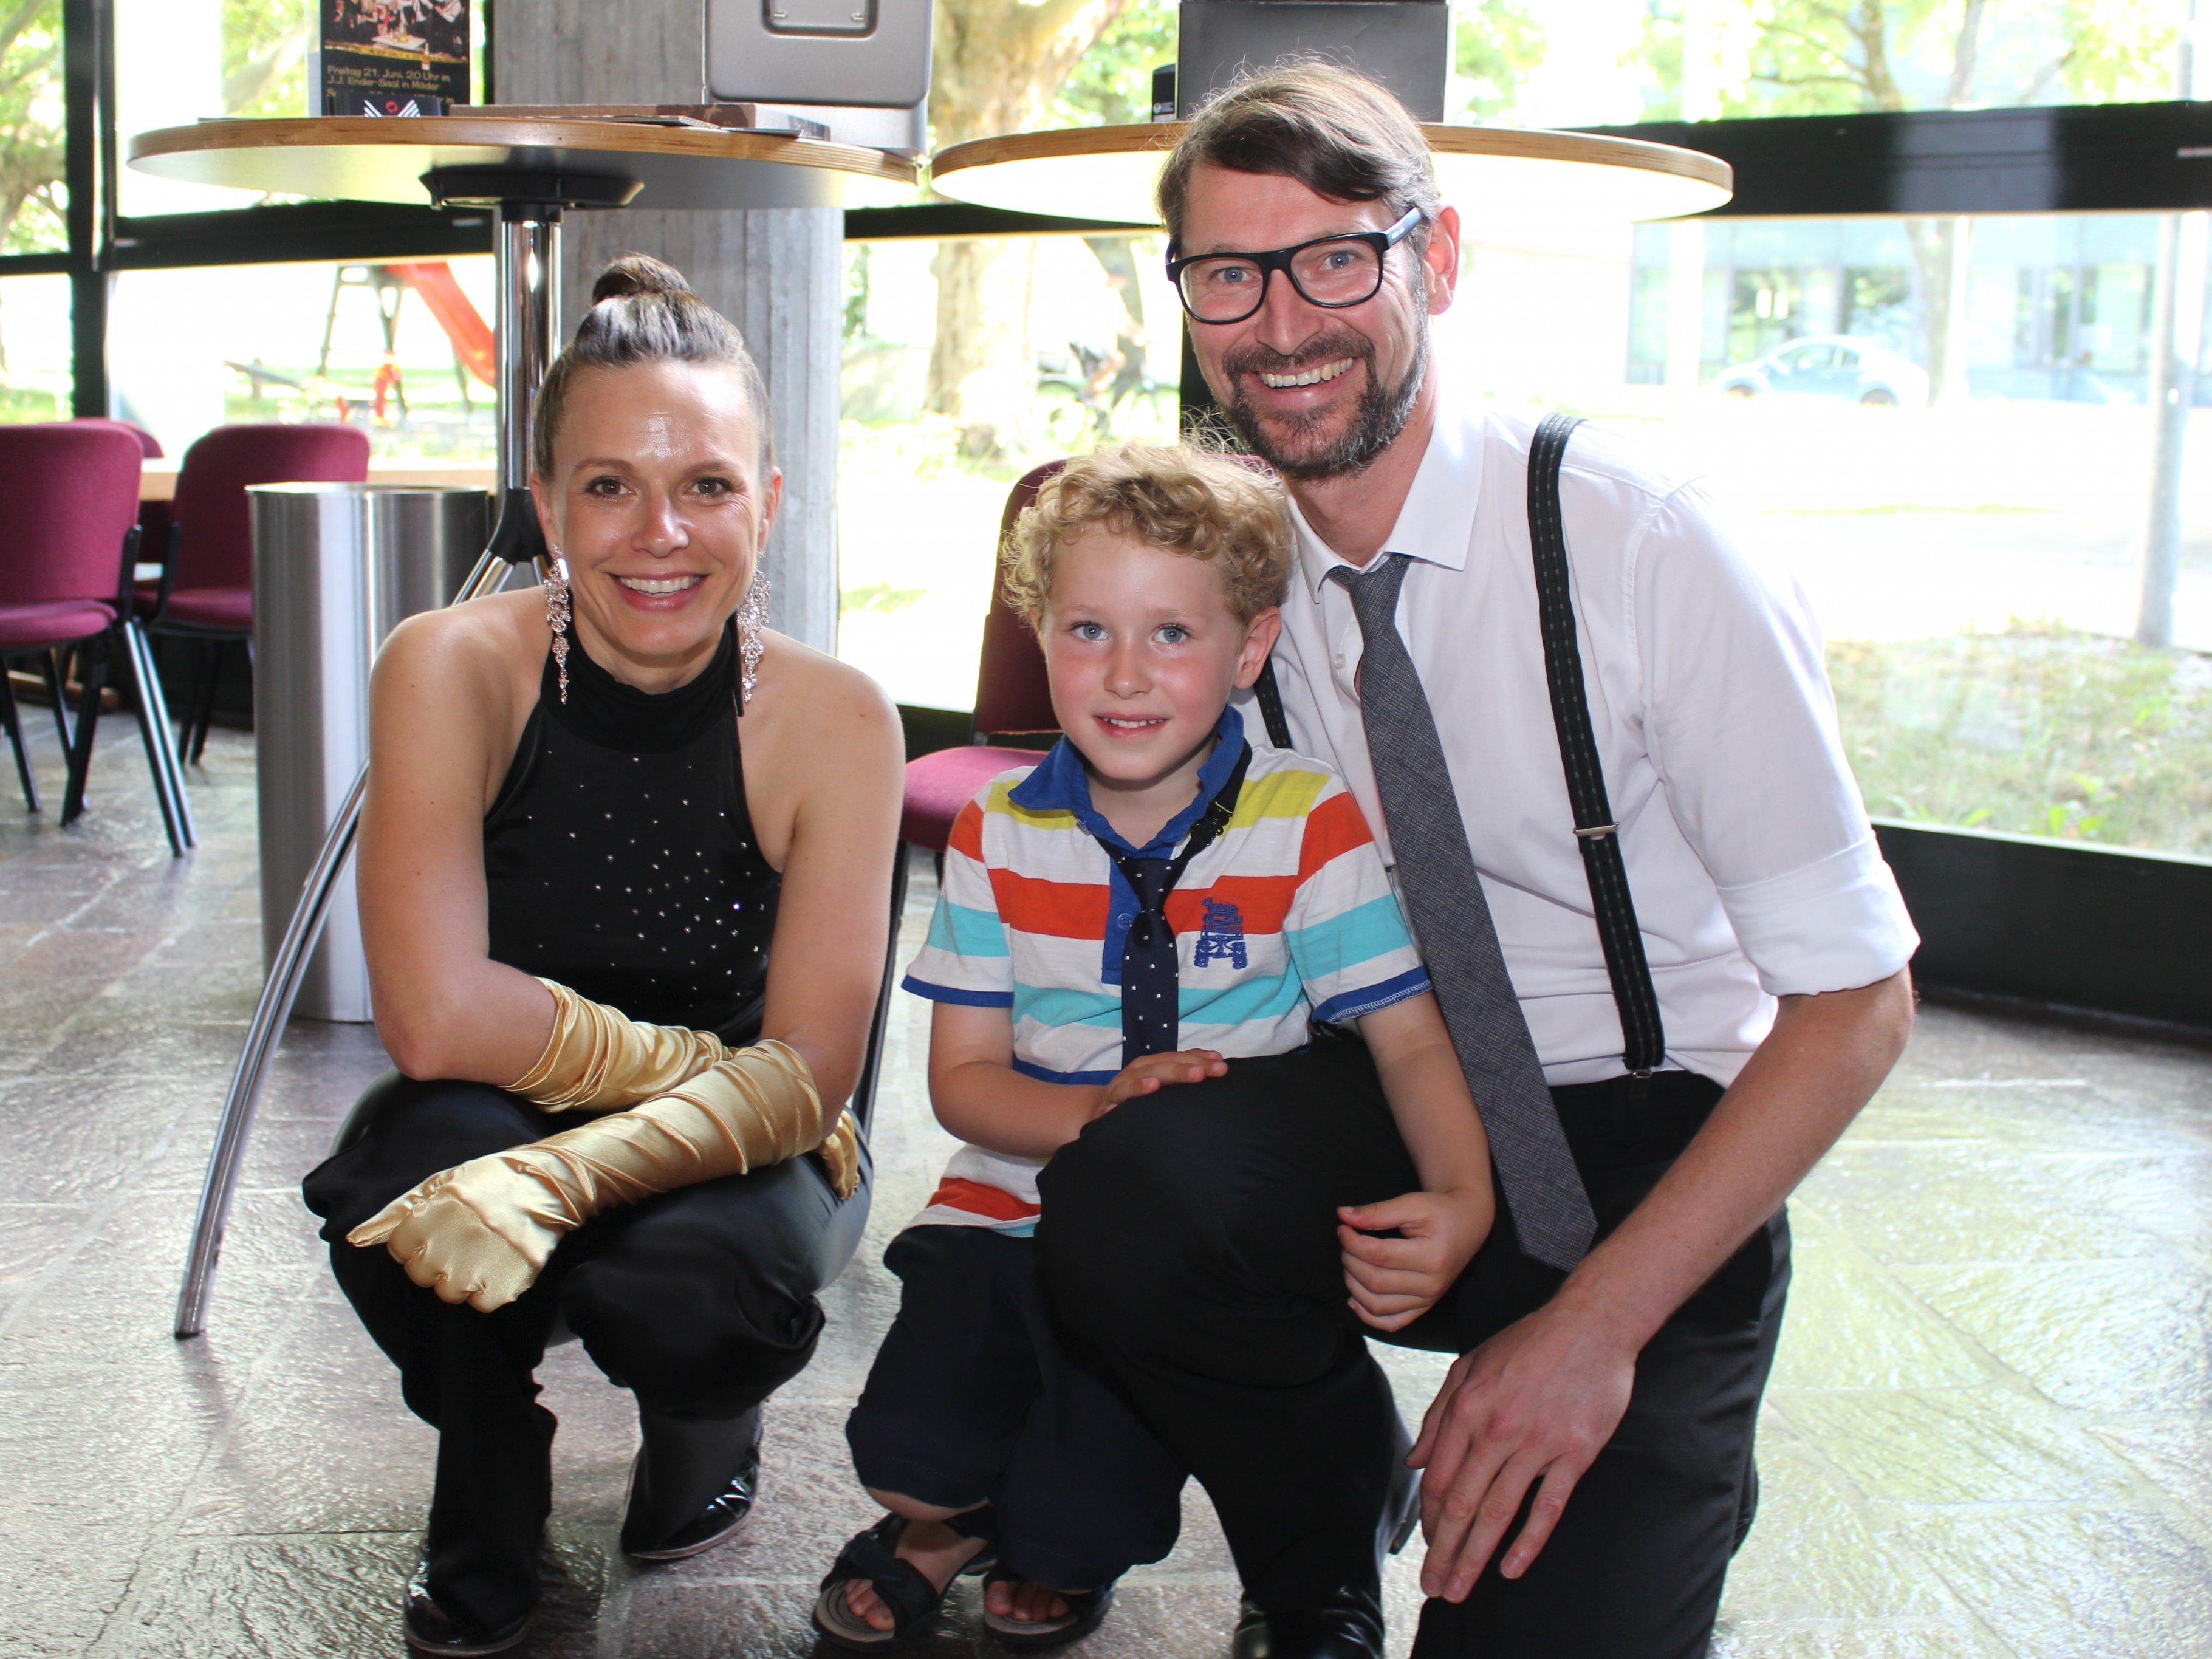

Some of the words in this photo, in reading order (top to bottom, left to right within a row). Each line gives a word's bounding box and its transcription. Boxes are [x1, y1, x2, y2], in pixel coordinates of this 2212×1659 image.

[327, 65, 361, 77] Freitag
[406, 70, 422, 80] 20
[422, 72, 439, 81] Uhr
[327, 75, 345, 85] J.J.
